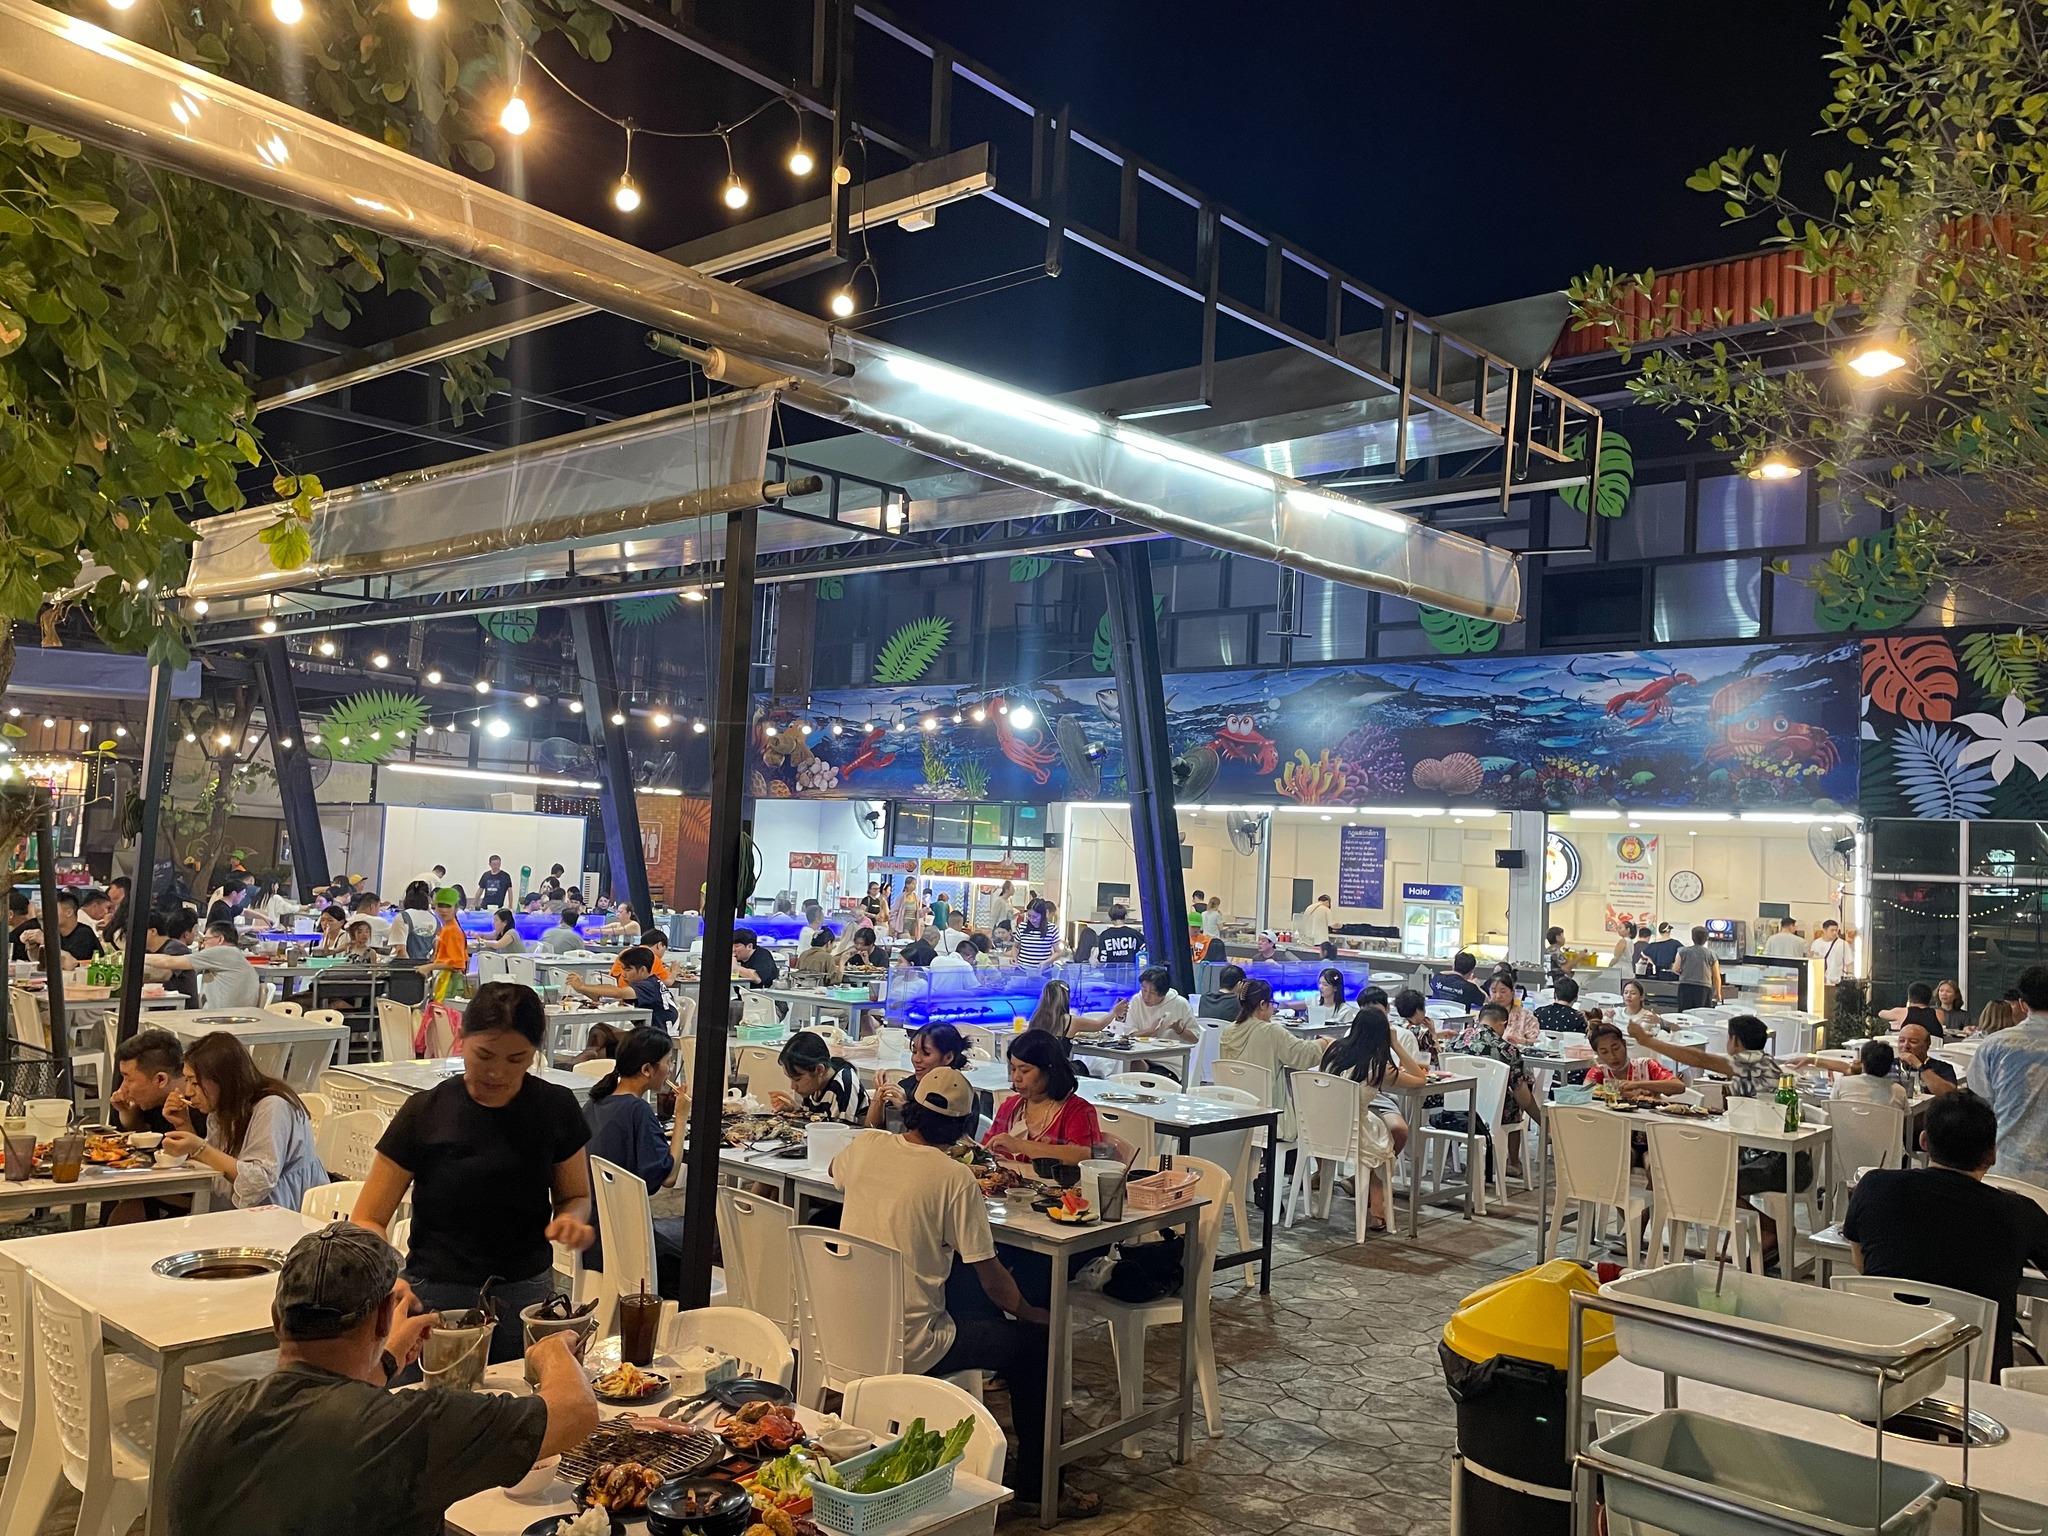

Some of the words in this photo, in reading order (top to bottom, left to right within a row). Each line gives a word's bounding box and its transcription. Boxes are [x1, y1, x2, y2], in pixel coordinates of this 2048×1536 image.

[822, 855, 836, 863] BBQ
[1619, 870, 1644, 881] เหลือ
[1408, 887, 1431, 896] Haier
